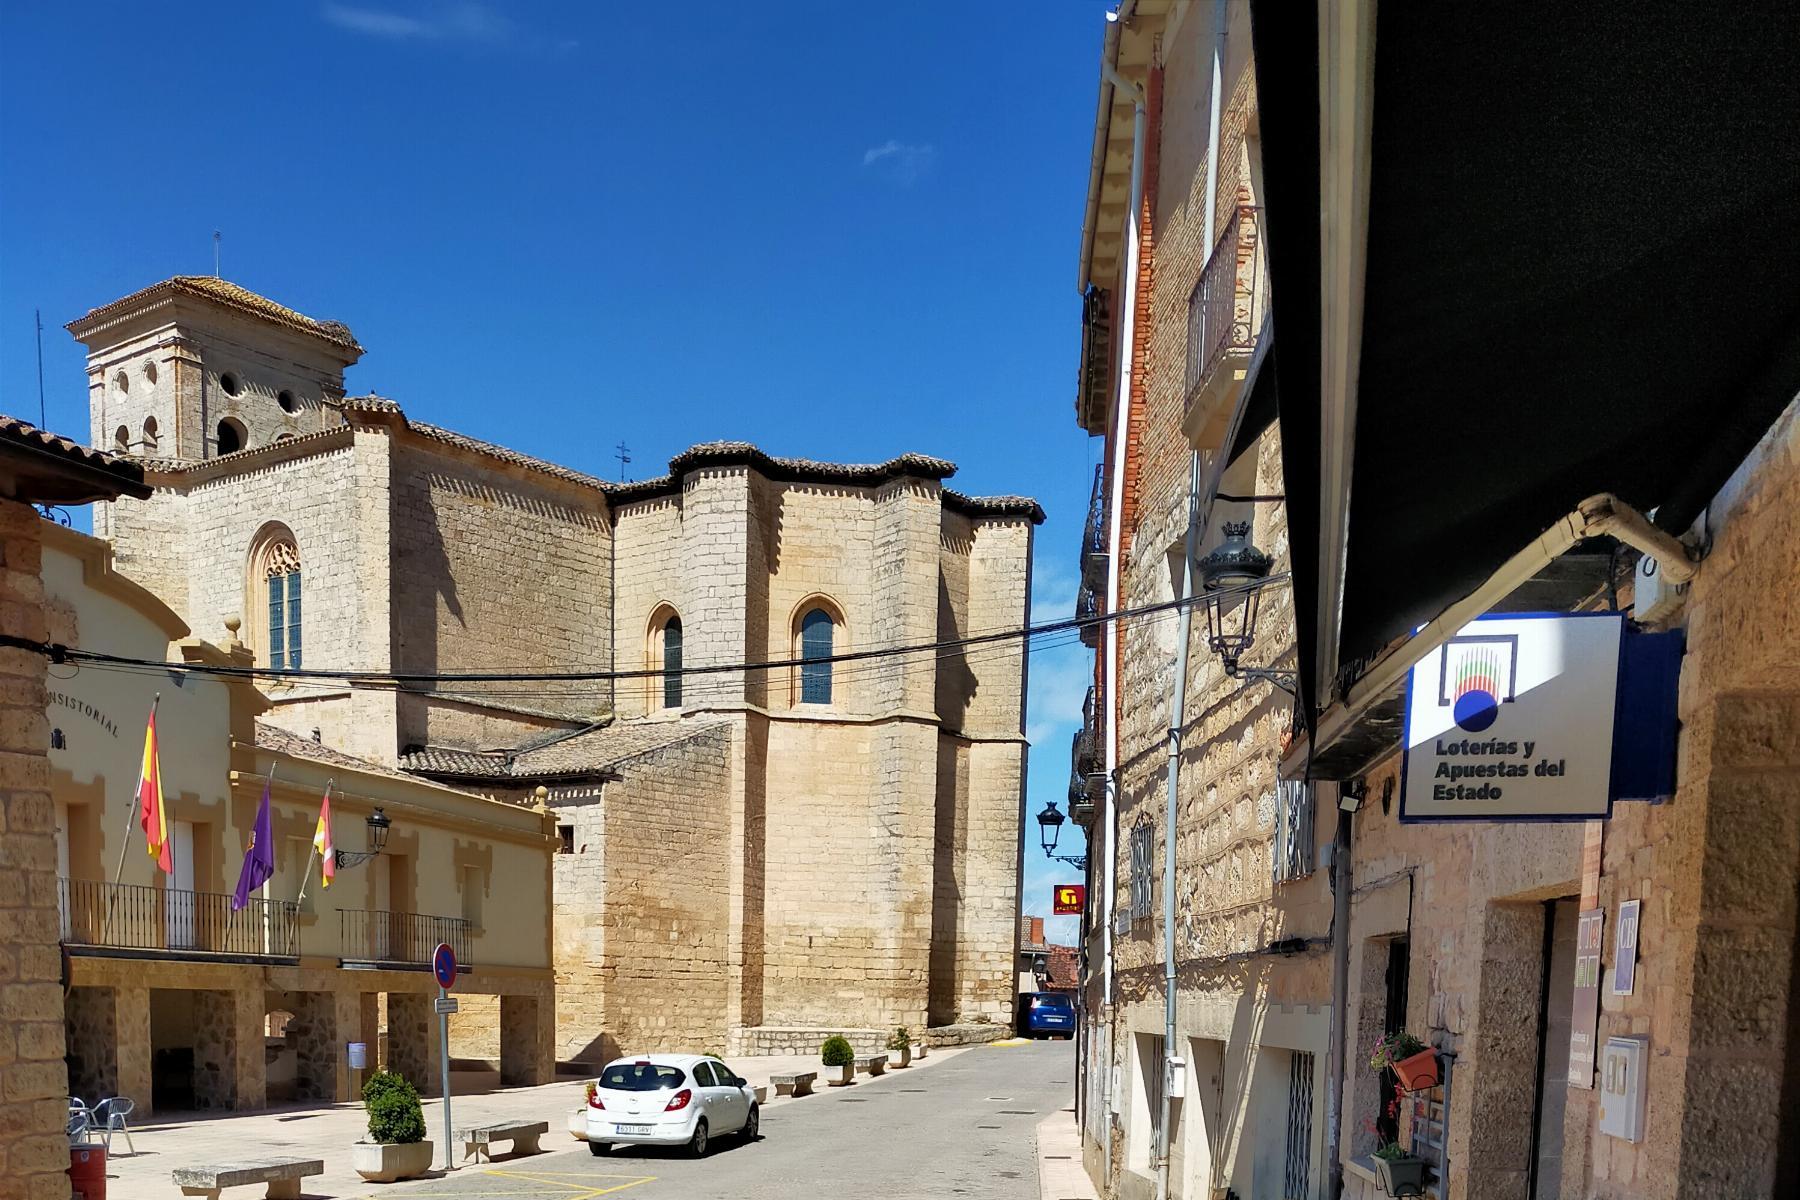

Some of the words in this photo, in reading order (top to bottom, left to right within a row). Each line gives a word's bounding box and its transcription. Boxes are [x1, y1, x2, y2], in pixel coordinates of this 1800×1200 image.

[1436, 738, 1517, 755] Loterías
[1523, 742, 1535, 759] y
[1435, 761, 1528, 782] Apuestas
[1534, 760, 1565, 777] del
[1433, 783, 1502, 800] Estado
[1621, 918, 1635, 949] CB
